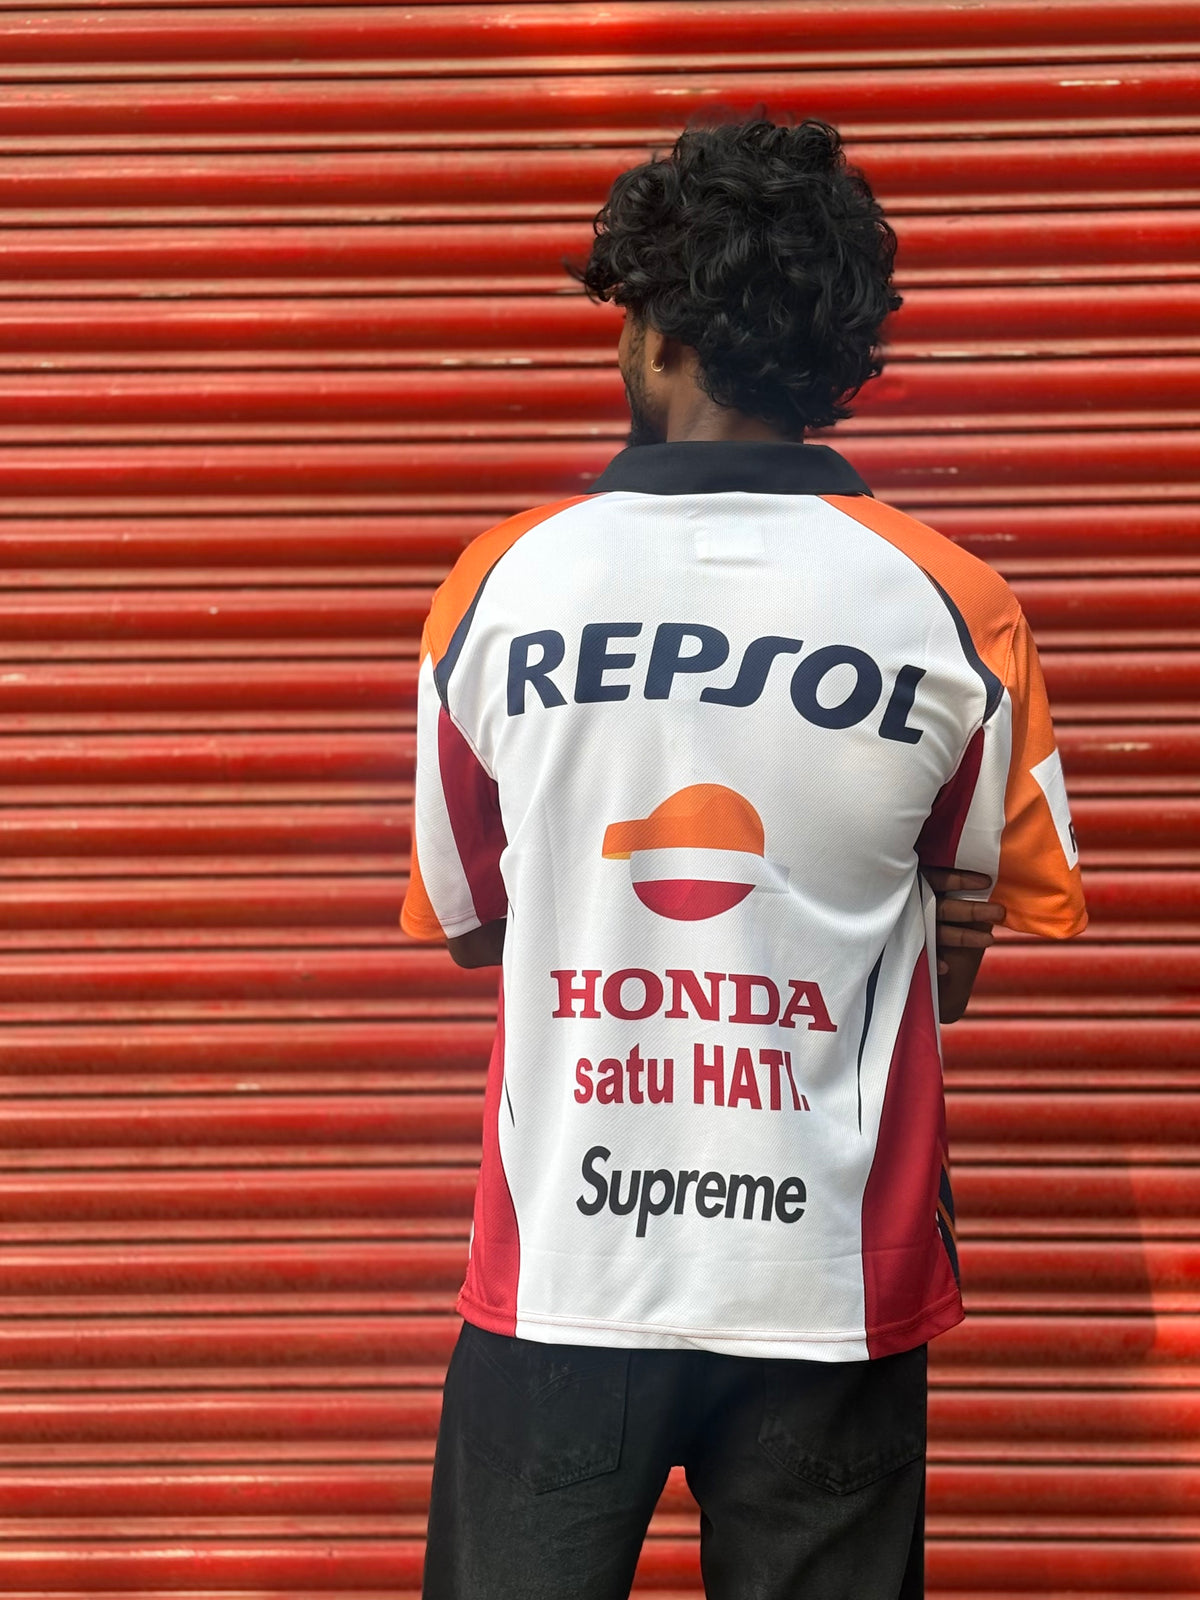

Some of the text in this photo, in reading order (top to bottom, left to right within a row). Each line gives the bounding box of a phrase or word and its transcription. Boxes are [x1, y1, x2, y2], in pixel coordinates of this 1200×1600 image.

[507, 622, 927, 744] REPSOL
[550, 968, 838, 1033] HONDA
[573, 1043, 674, 1105] satu
[575, 1145, 807, 1238] Supreme
